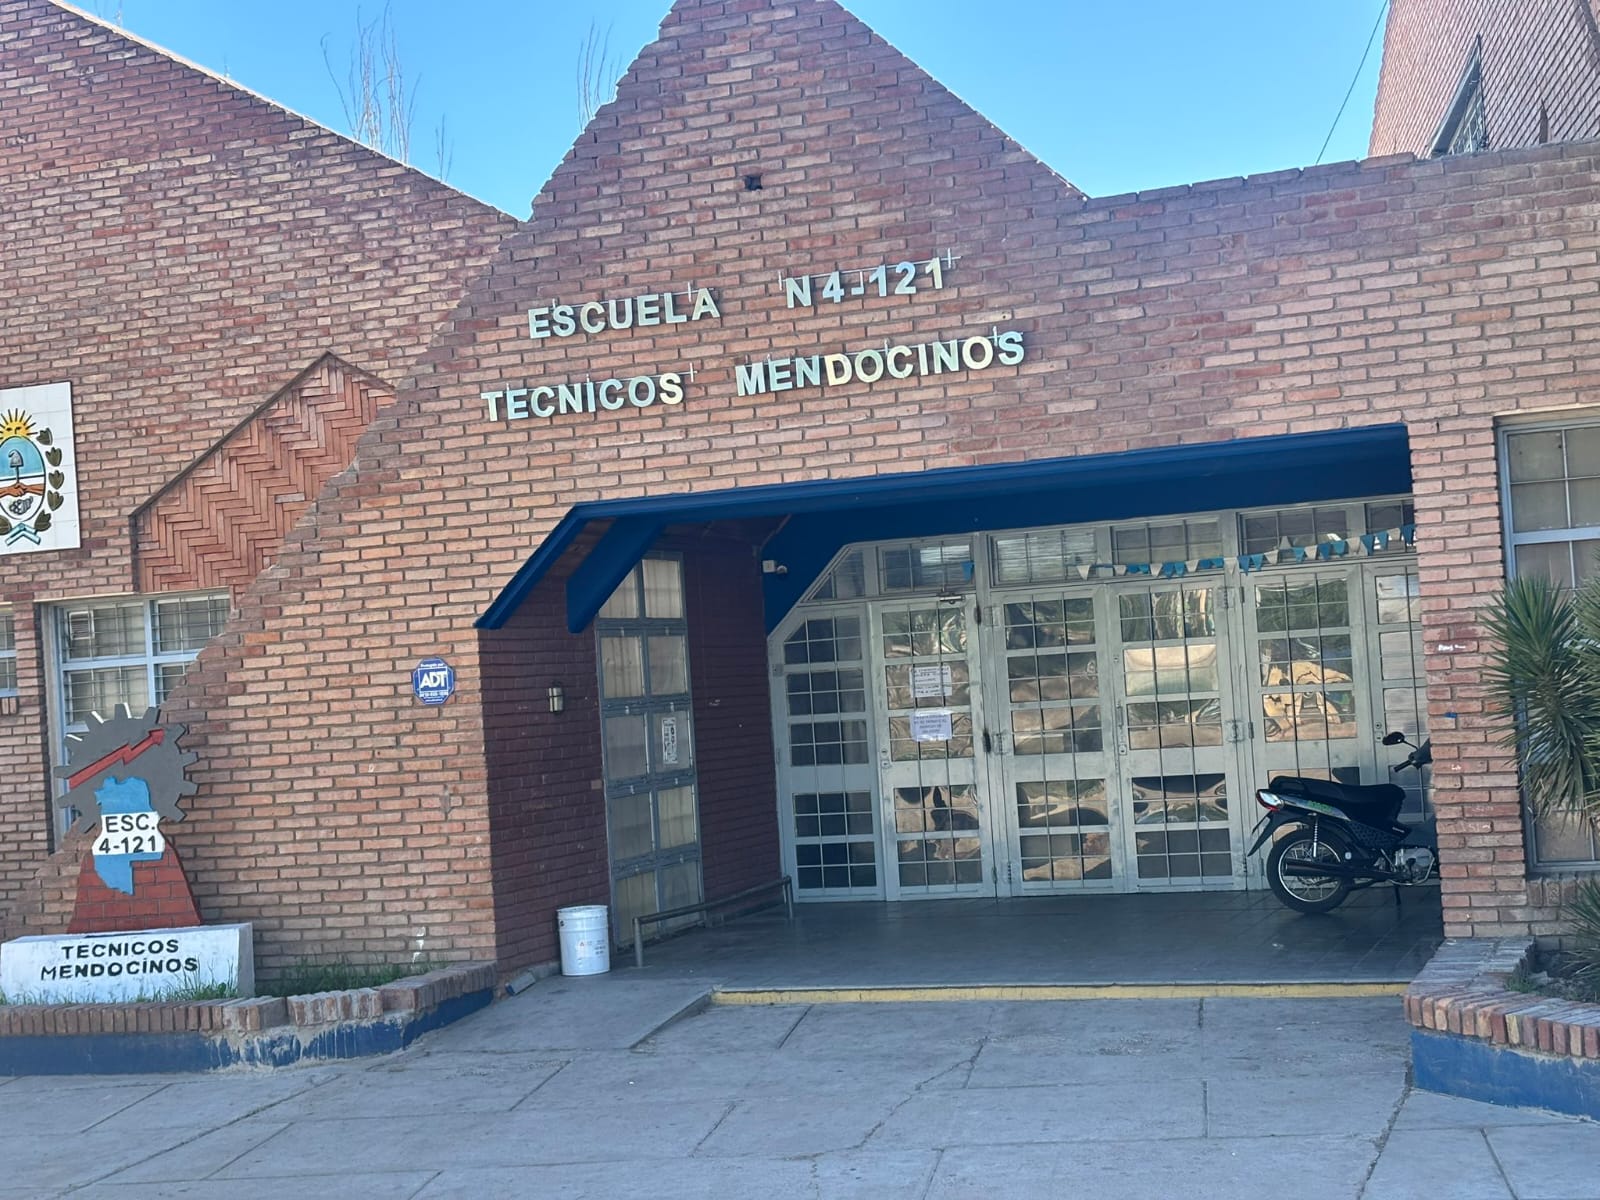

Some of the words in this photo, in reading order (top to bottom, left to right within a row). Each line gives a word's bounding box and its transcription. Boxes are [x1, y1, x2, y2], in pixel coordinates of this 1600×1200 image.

[528, 288, 721, 339] ESCUELA
[786, 275, 812, 308] N
[822, 257, 943, 303] 4-121
[481, 372, 684, 422] TECNICOS
[735, 331, 1025, 396] MENDOCINOS
[420, 670, 447, 689] ADT
[105, 814, 156, 833] ESC.
[99, 835, 156, 854] 4-121
[61, 939, 179, 960] TECNICOS
